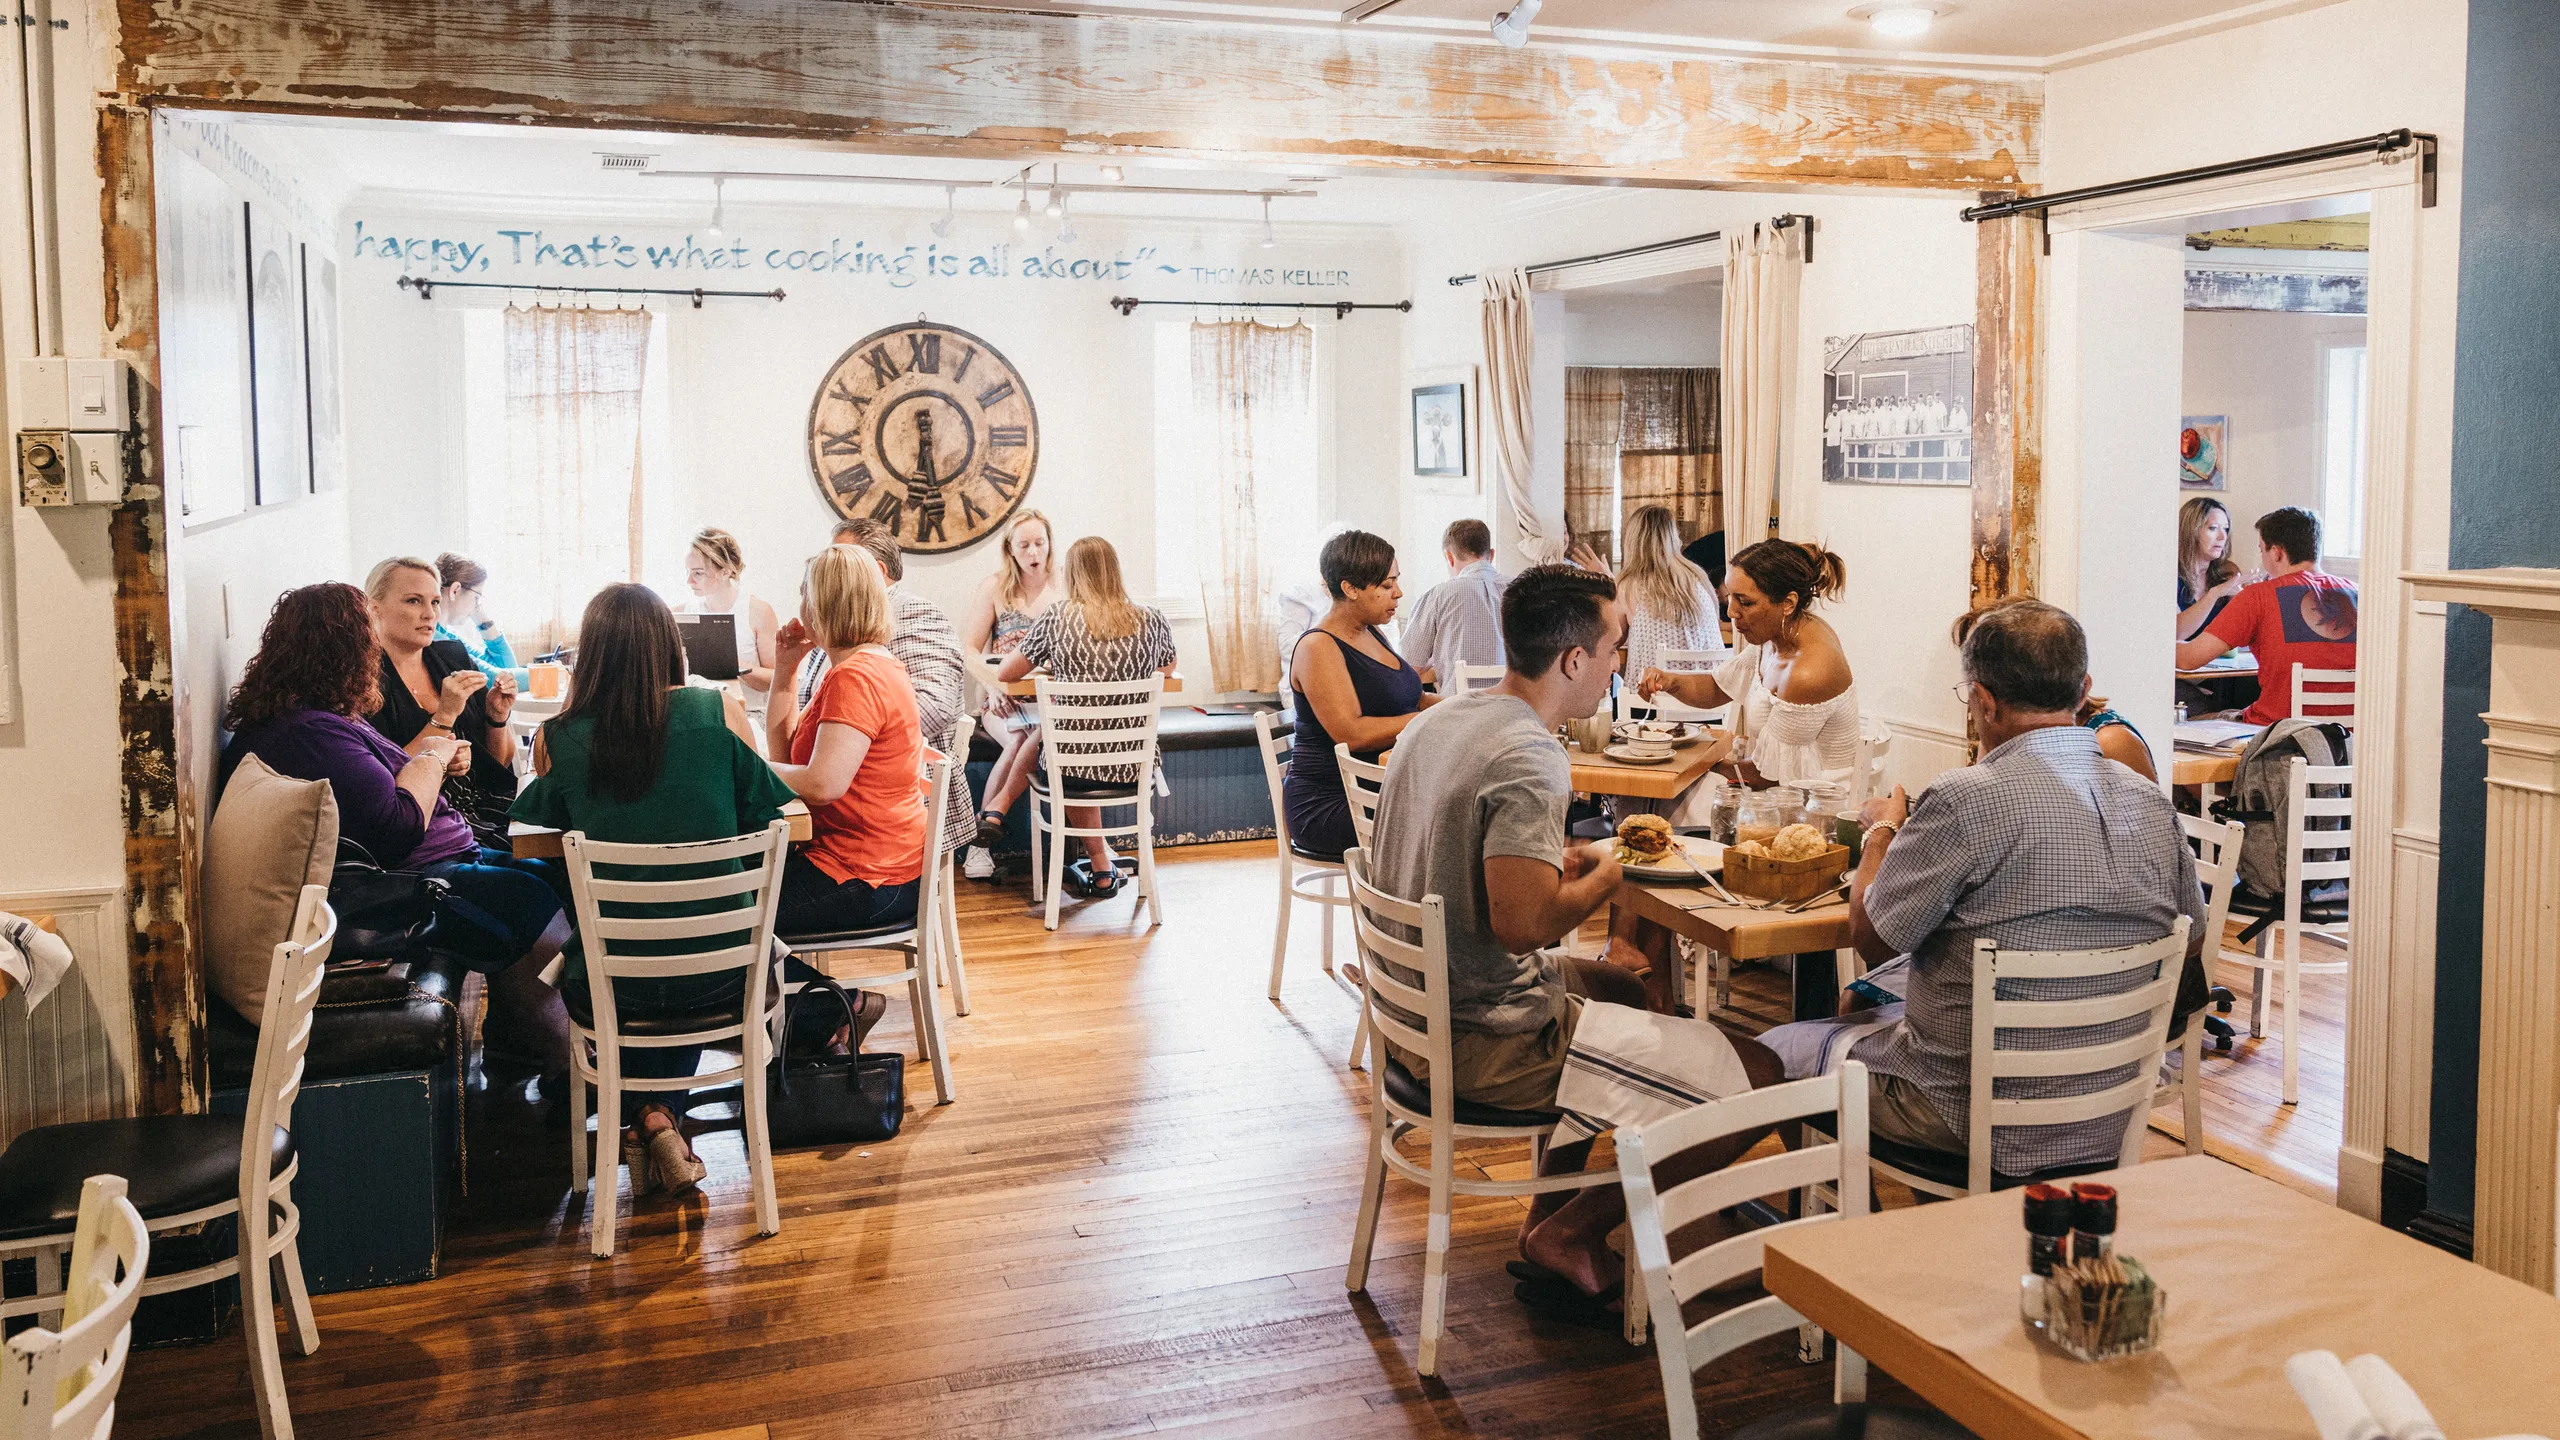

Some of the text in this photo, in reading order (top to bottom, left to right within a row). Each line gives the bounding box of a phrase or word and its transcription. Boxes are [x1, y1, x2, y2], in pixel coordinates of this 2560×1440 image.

[354, 220, 490, 273] happy,
[497, 229, 639, 269] That's
[646, 233, 750, 271] what
[765, 237, 918, 288] cooking
[928, 243, 959, 277] is
[968, 243, 1010, 279] all
[1190, 267, 1275, 285] THOMAS
[1282, 268, 1350, 287] KELLER
